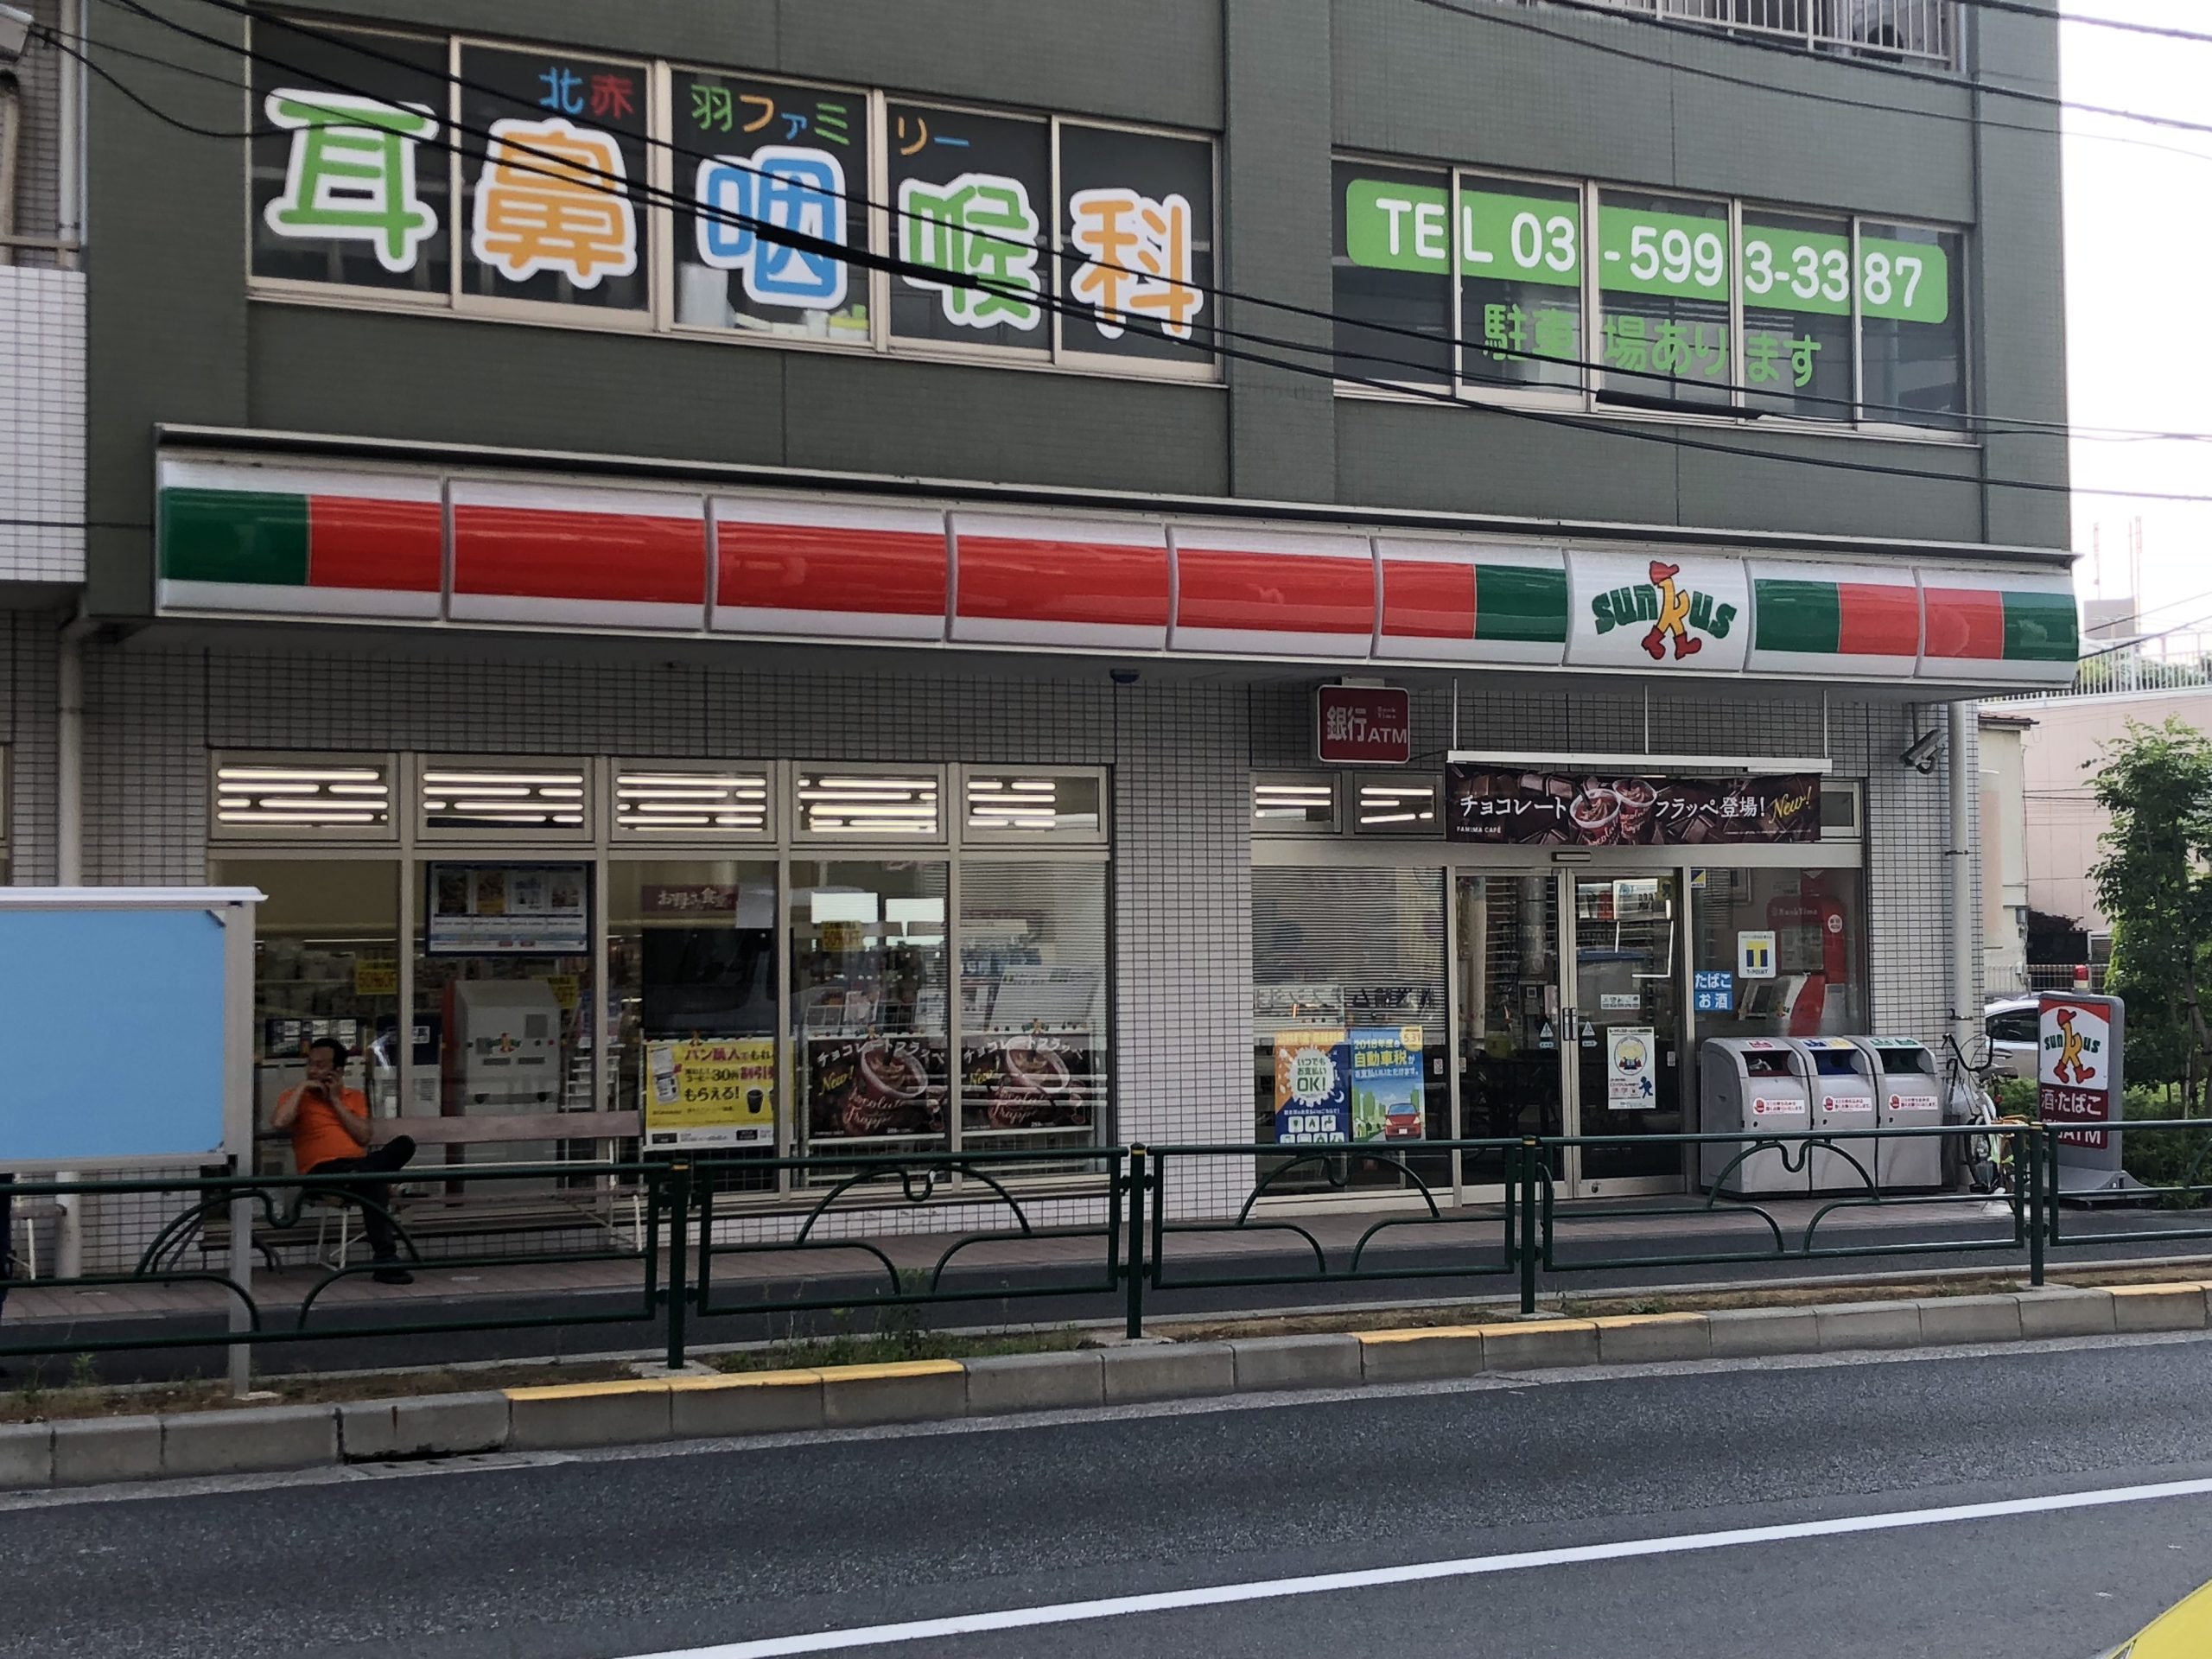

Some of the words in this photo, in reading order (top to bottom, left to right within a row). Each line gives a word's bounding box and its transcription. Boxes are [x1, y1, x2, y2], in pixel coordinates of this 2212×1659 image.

[539, 67, 969, 156] 北赤羽ファミリー
[264, 87, 1205, 340] 耳鼻咽喉科
[1376, 197, 1494, 264] TEL
[1510, 212, 1923, 308] 03-5993-3387
[1483, 303, 1822, 388] 駐車場あります
[1459, 794, 1567, 820] チョコレート
[1694, 973, 1732, 989] たばこ
[1699, 993, 1728, 1009] お酒
[684, 1086, 740, 1102] もらえる!
[1297, 1077, 1326, 1092] OK!
